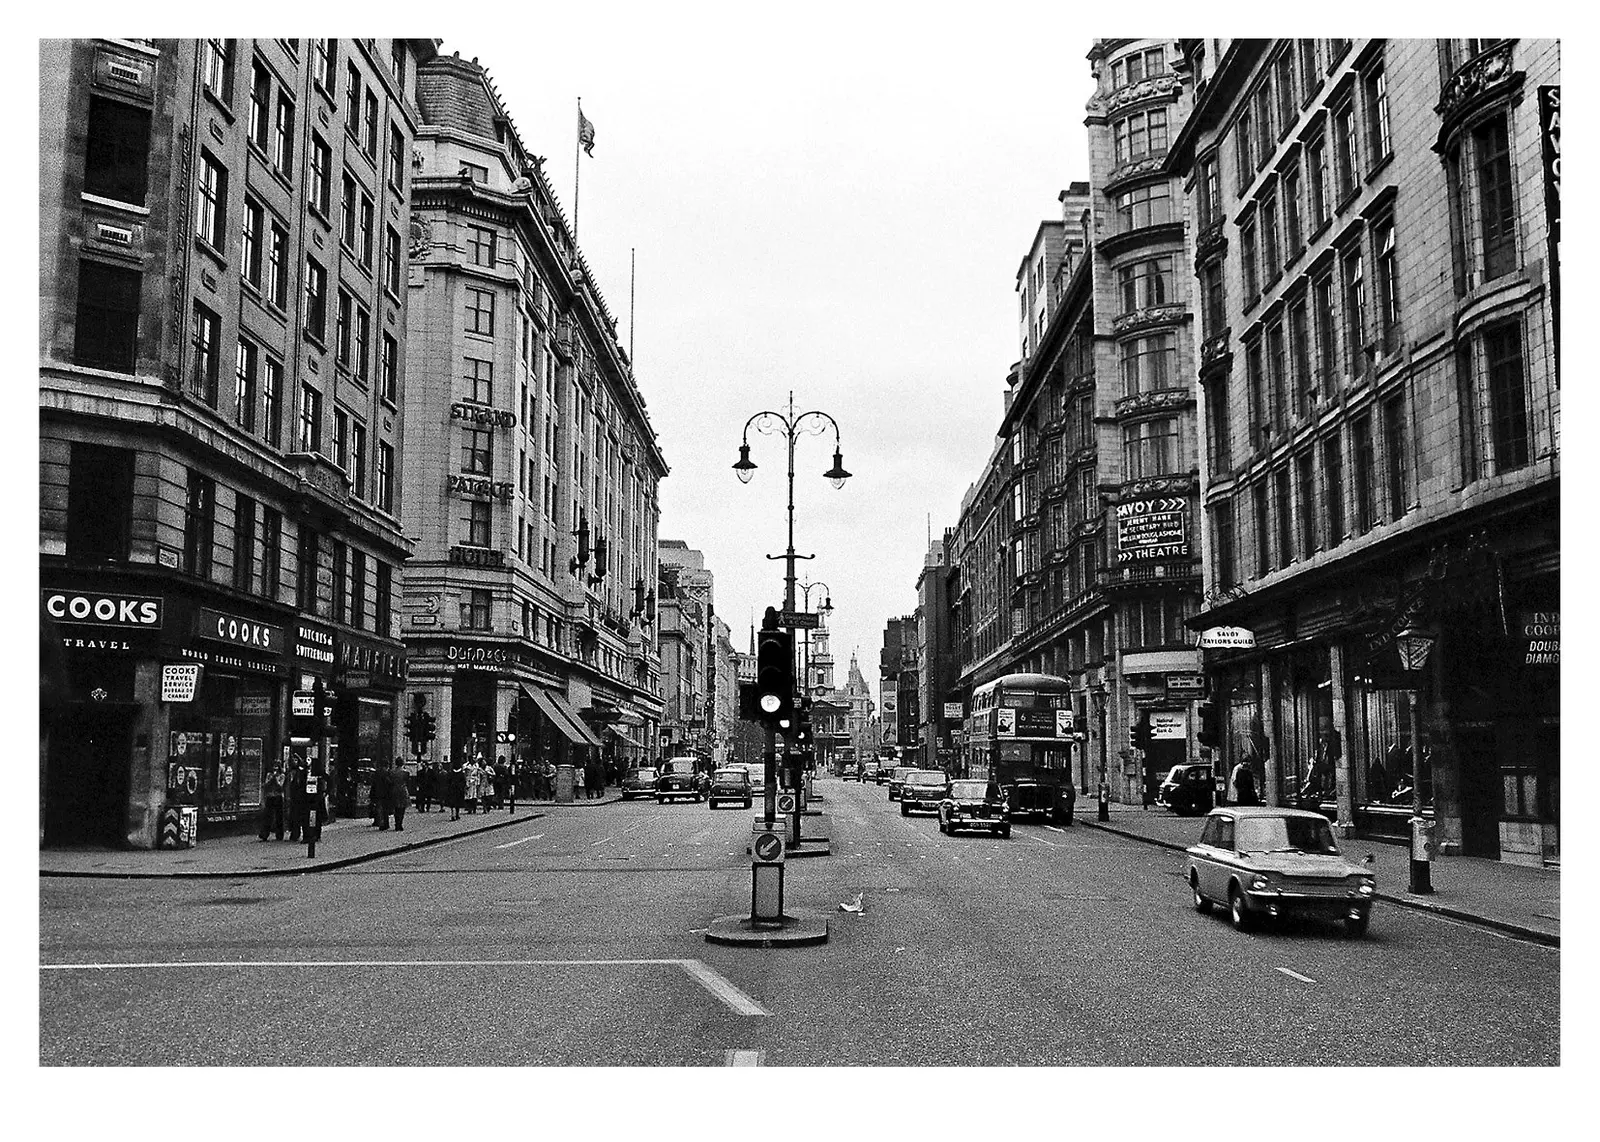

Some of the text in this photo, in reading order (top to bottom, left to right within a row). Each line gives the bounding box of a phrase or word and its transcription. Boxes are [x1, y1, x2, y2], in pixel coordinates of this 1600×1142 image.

[451, 402, 517, 429] STRAND
[447, 475, 514, 500] PALACE
[1116, 500, 1154, 517] SAVOY
[1135, 545, 1188, 559] THEATRE
[47, 595, 157, 624] COOKS
[217, 616, 270, 647] COOKS
[299, 627, 327, 645] WATCHES
[63, 638, 130, 650] TRAVEL
[296, 644, 335, 664] SWITZERLAND
[181, 648, 276, 673] WORLD TRAVEL SERVICE
[164, 667, 196, 675] COOKS
